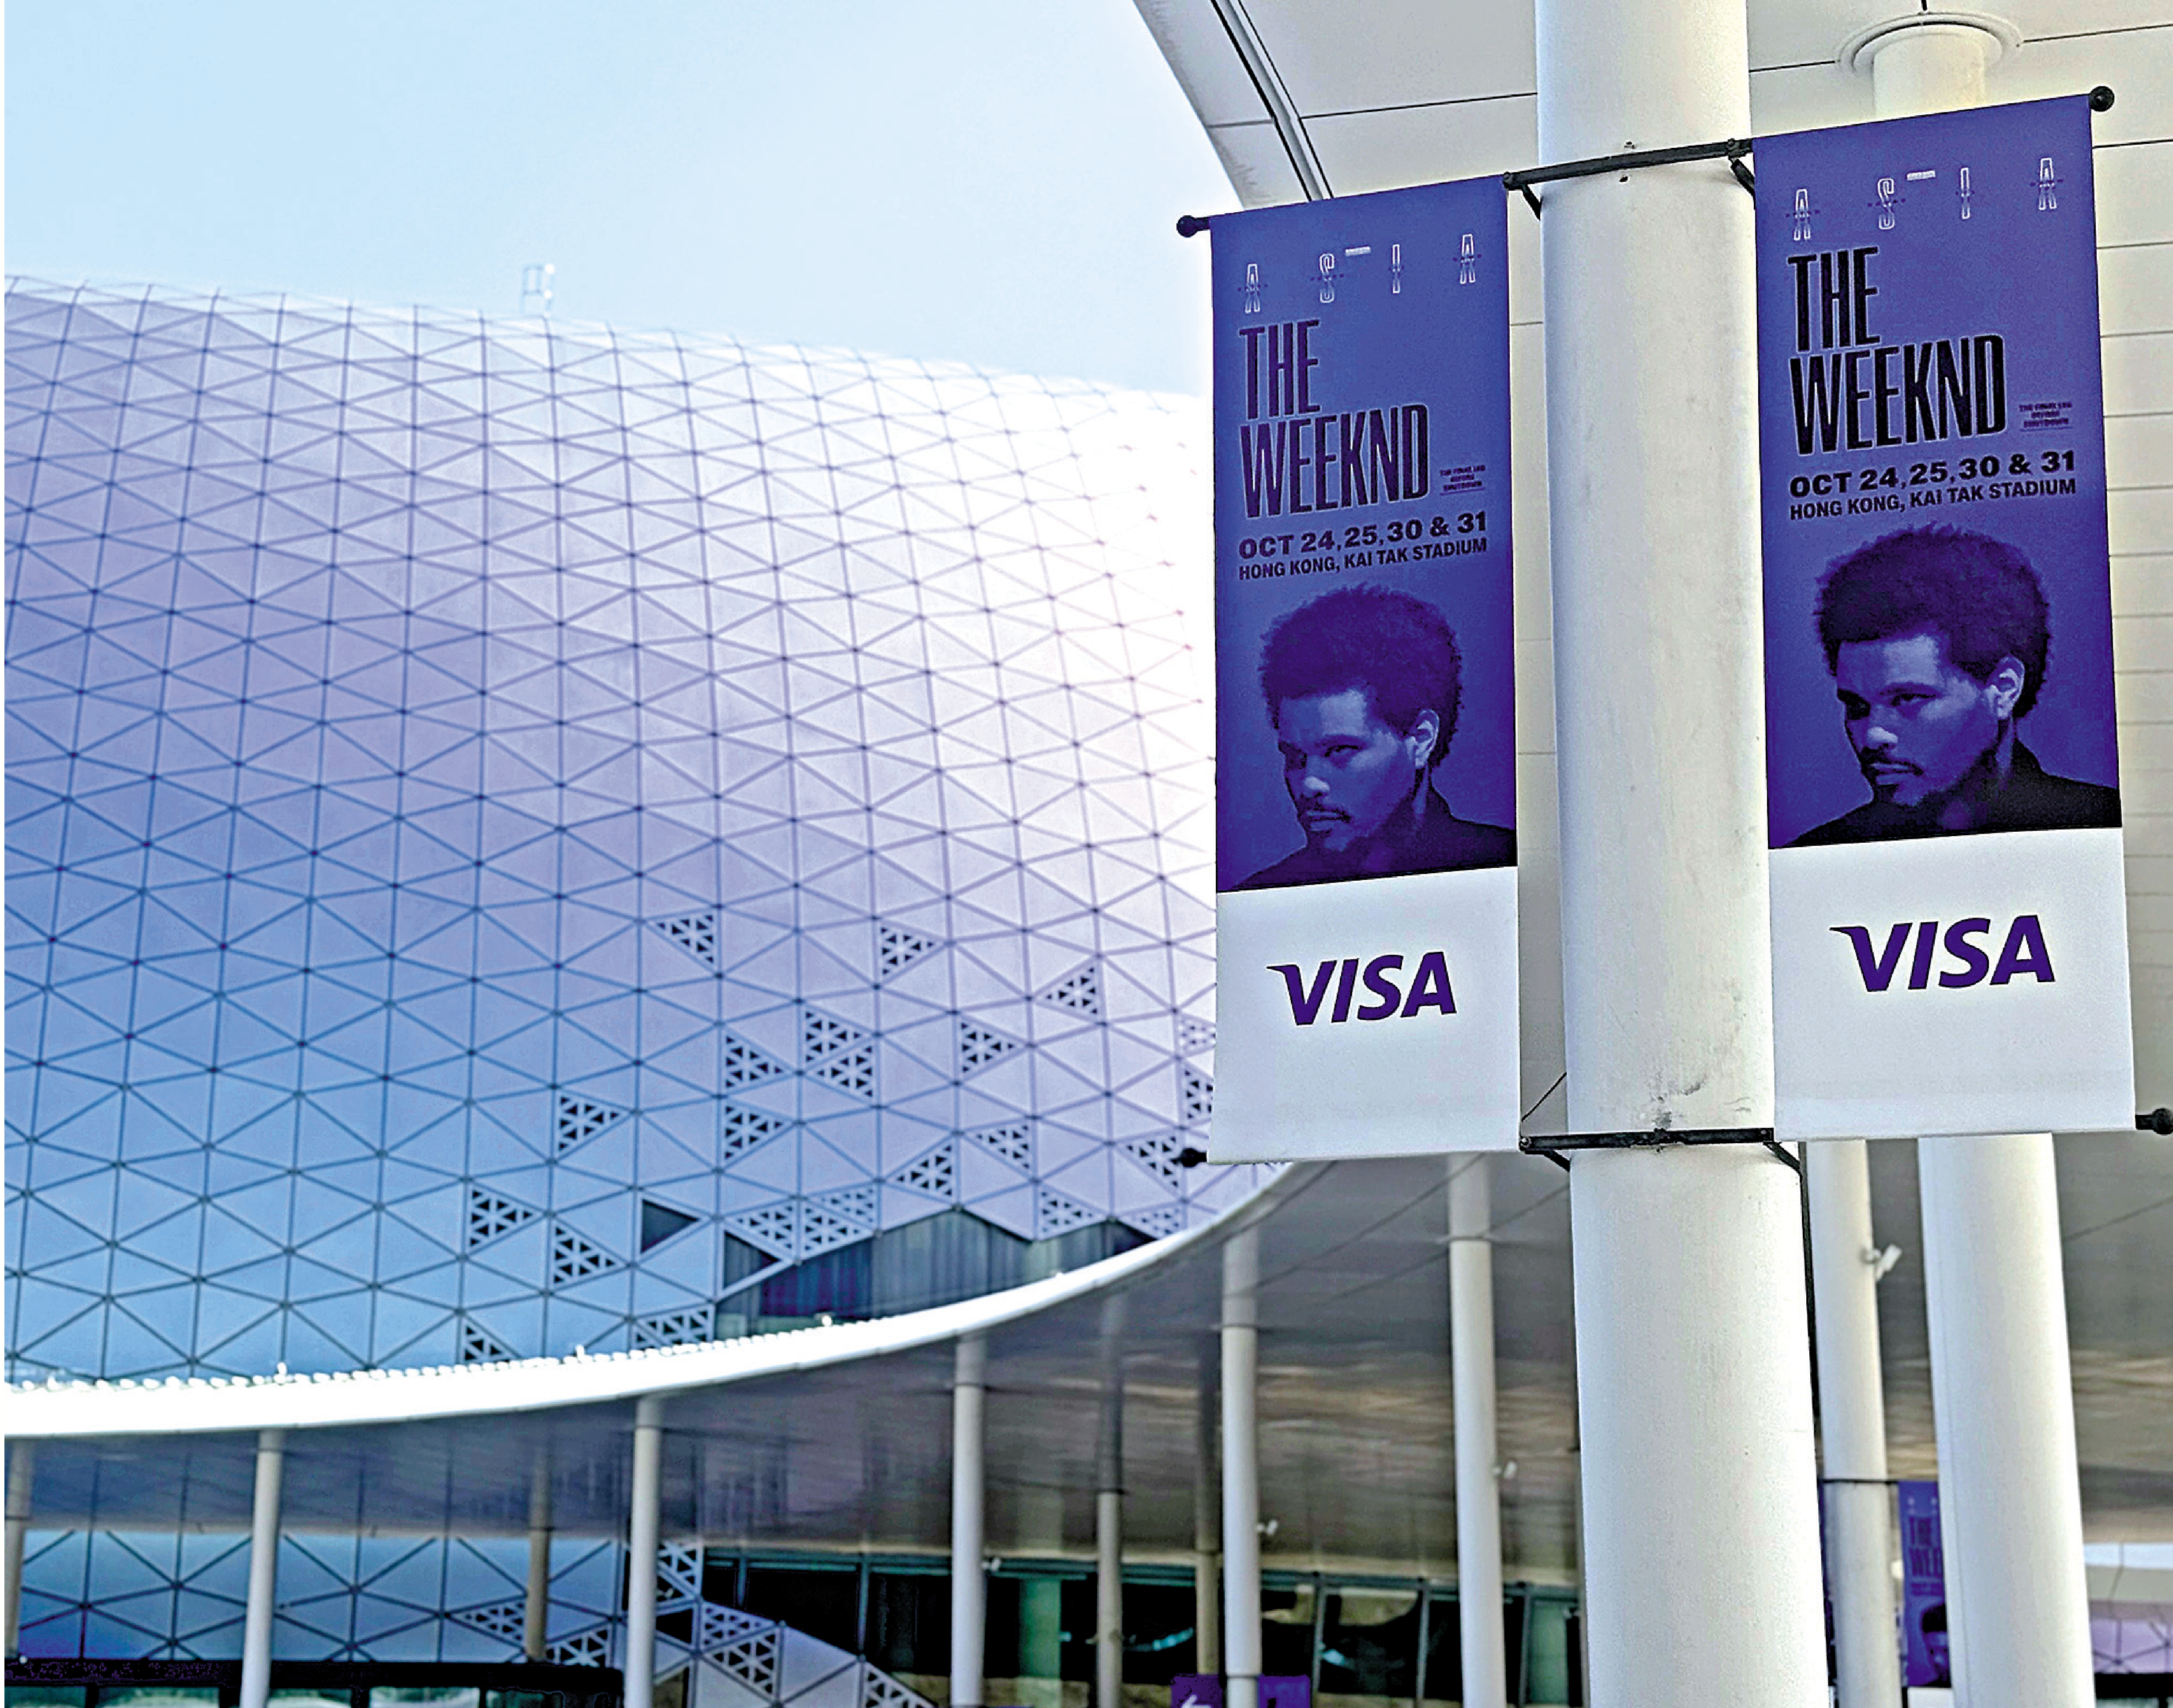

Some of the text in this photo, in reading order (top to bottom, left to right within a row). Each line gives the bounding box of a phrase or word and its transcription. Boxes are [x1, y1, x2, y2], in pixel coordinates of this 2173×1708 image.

[1787, 246, 1881, 353] THE
[1239, 319, 1320, 420] THE
[1790, 334, 2006, 455] WEEKND
[1240, 404, 1429, 518] WEEKND
[1790, 472, 1852, 498] OCT
[2009, 454, 2032, 475] &
[2041, 450, 2074, 473] 31
[1239, 534, 1294, 559] OCT
[1430, 516, 1450, 537] &
[1457, 510, 1485, 533] 31
[1790, 478, 2076, 520] HONG KONG, KAI TAK STADIUM
[1240, 537, 1487, 580] HONG KONG, KAI TAK STADIUM
[1266, 951, 1456, 1025] VISA
[1829, 915, 2056, 992] VISA
